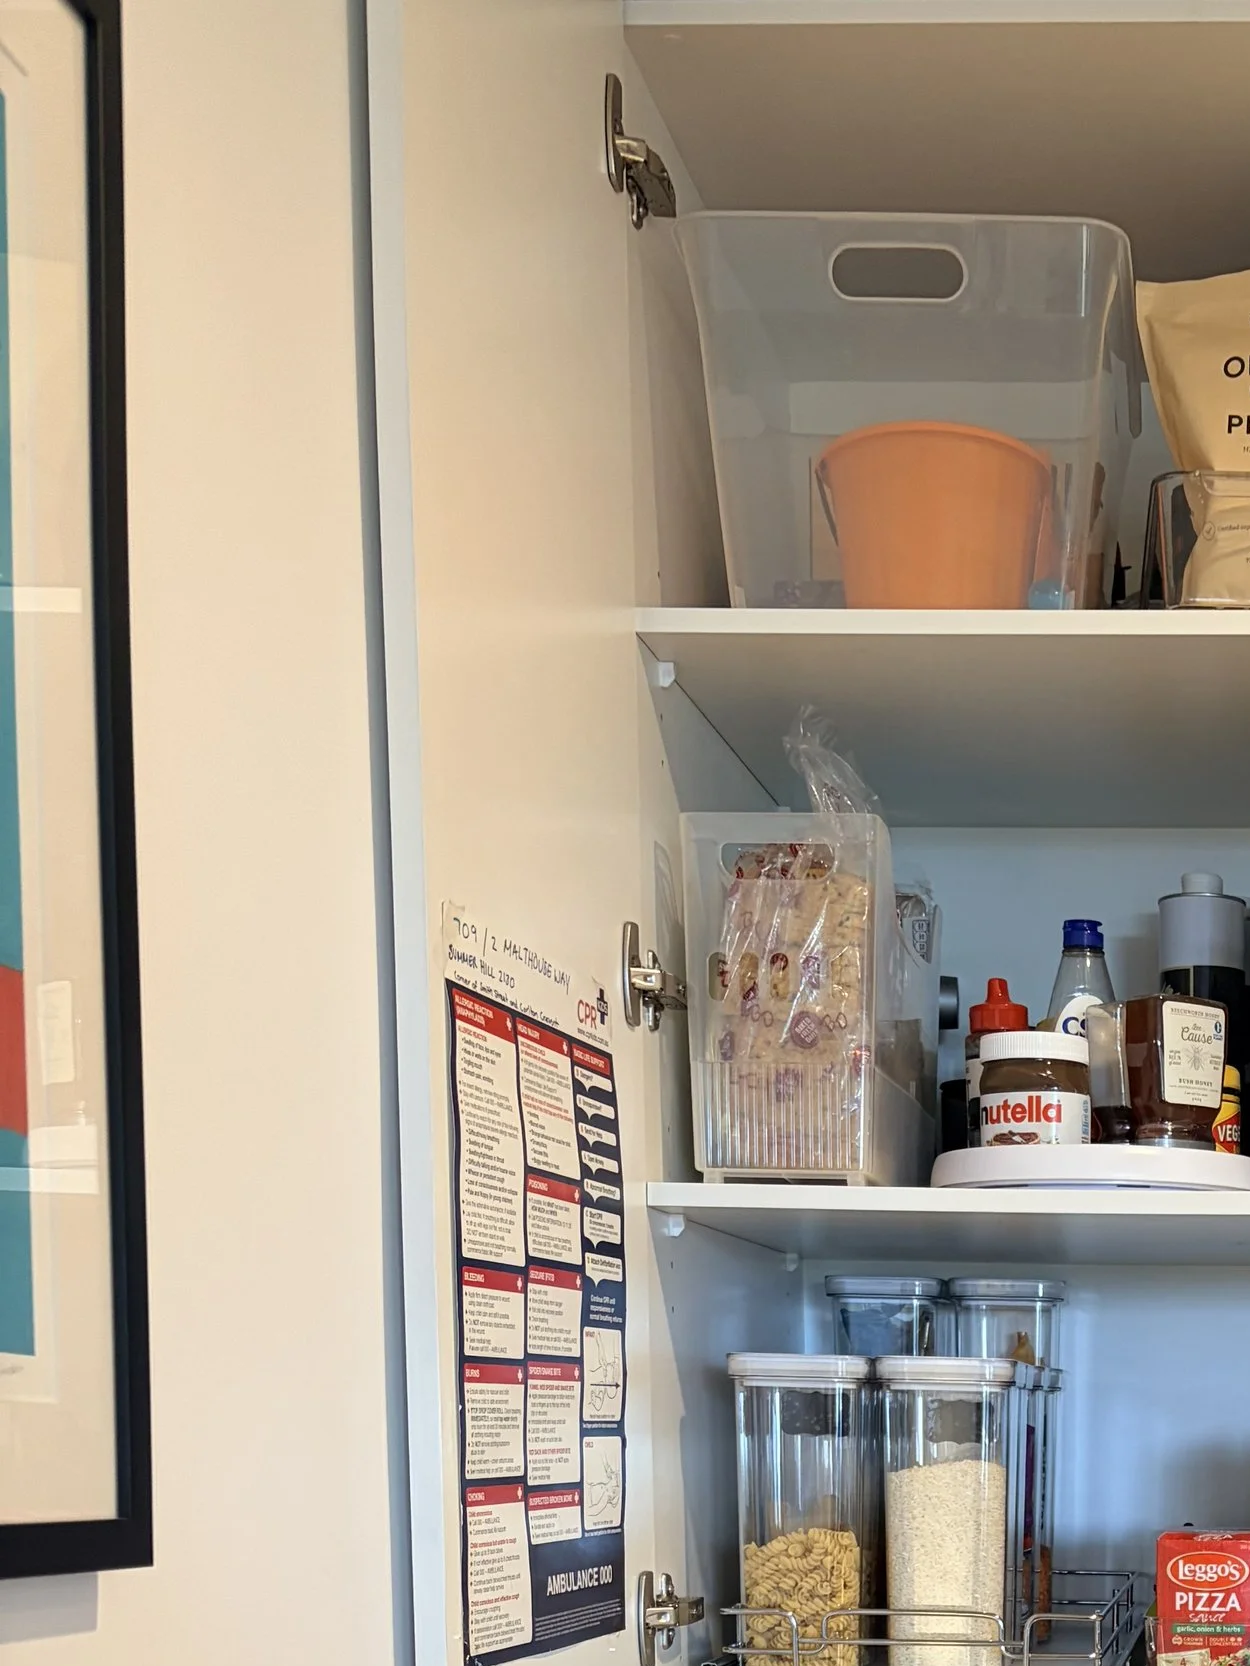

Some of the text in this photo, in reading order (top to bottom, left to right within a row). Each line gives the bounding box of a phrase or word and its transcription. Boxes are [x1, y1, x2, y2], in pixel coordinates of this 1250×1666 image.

[448, 943, 478, 969] SUMMER
[480, 959, 495, 979] HILL
[453, 917, 477, 943] 709
[503, 939, 552, 979] MALTHOUSE
[554, 969, 571, 996] WAY
[577, 999, 597, 1030] CPR
[1062, 1016, 1086, 1038] CS
[1181, 1026, 1213, 1045] Cause
[981, 1095, 1062, 1125] nutella
[1217, 1124, 1240, 1142] VEG
[464, 1272, 485, 1282] BLEEDING
[465, 1369, 480, 1378] BURNS
[547, 1564, 613, 1597] AMBULANCE 000
[1178, 1559, 1241, 1582] Leggo's
[1175, 1591, 1241, 1612] PIZZA
[1176, 1625, 1196, 1634] garlic,
[1180, 1658, 1187, 1666] 4
